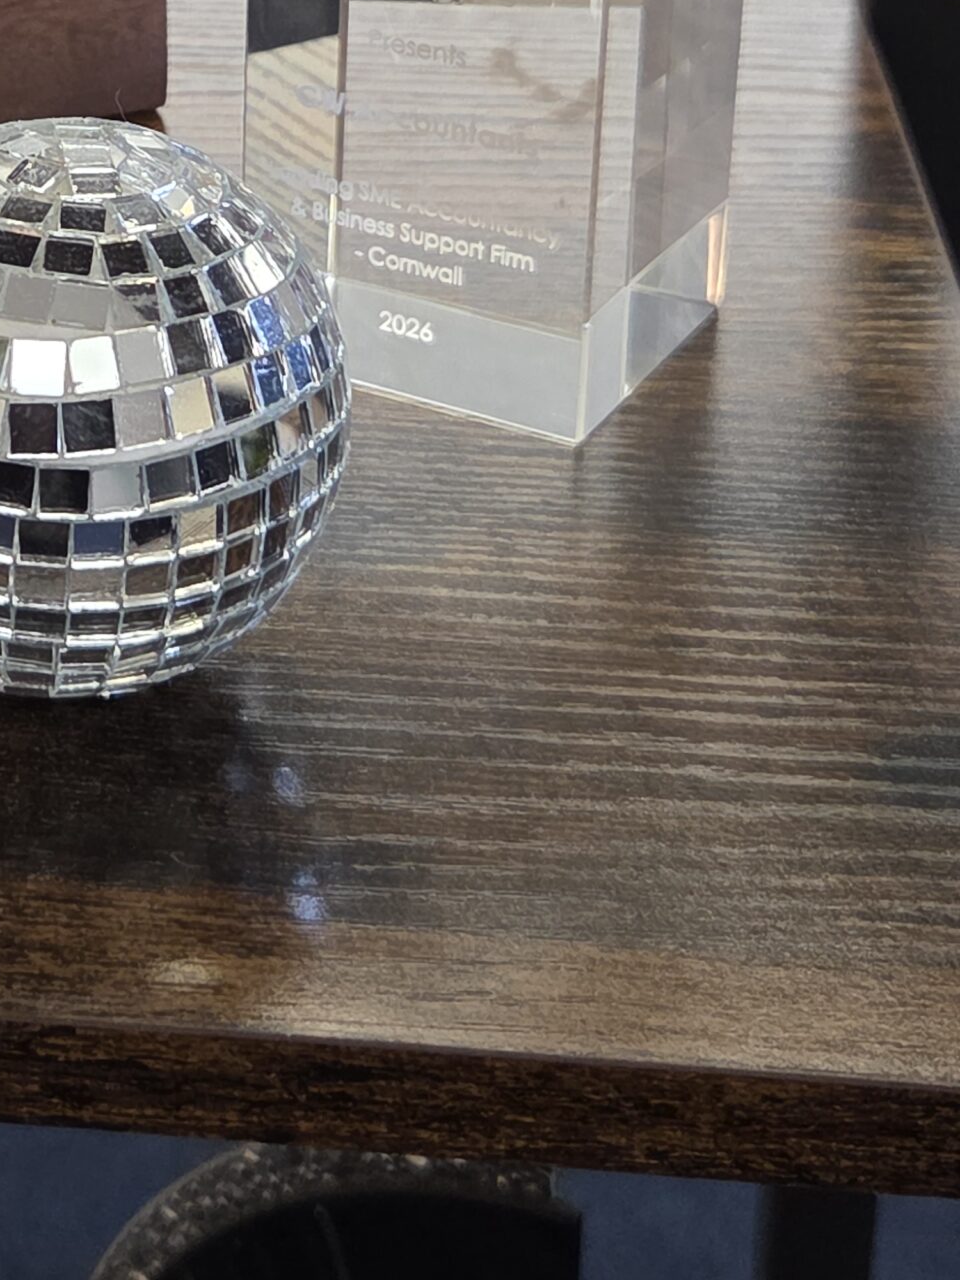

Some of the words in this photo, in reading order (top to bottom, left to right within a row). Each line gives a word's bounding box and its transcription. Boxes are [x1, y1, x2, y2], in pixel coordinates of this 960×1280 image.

[367, 246, 463, 287] Cornwall
[399, 222, 486, 264] Support
[490, 244, 535, 273] Firm
[378, 310, 434, 343] 2026
